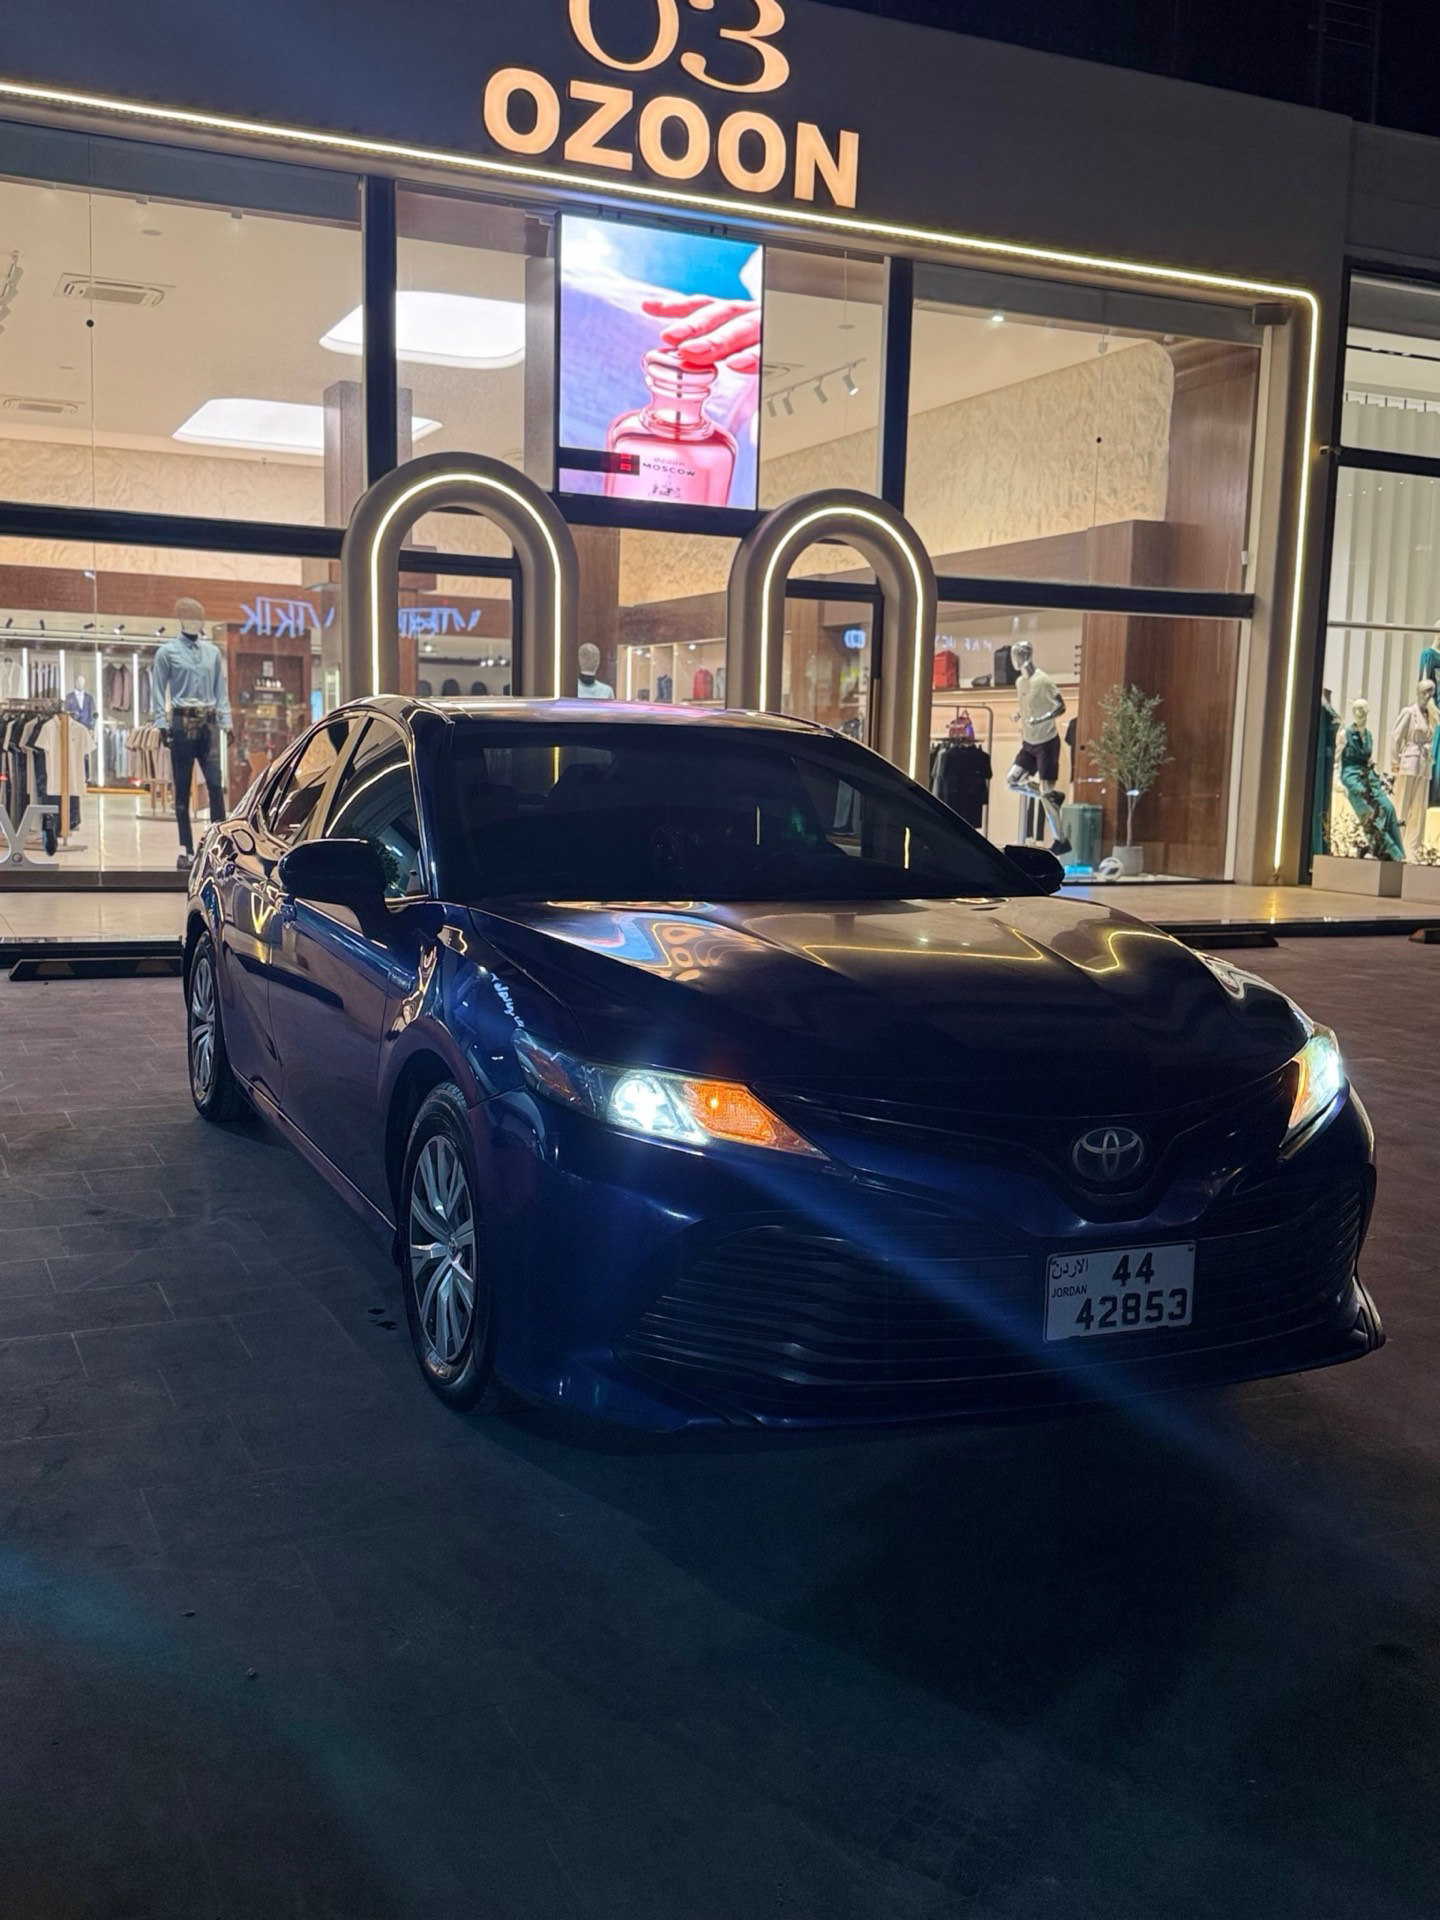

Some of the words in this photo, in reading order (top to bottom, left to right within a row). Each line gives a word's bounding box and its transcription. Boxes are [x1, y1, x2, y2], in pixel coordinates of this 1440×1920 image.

[484, 67, 860, 209] OZOON
[643, 463, 696, 476] MOSCOW
[1112, 1252, 1155, 1287] 44
[1051, 1284, 1088, 1298] JORDAN
[1075, 1288, 1188, 1330] 42853
